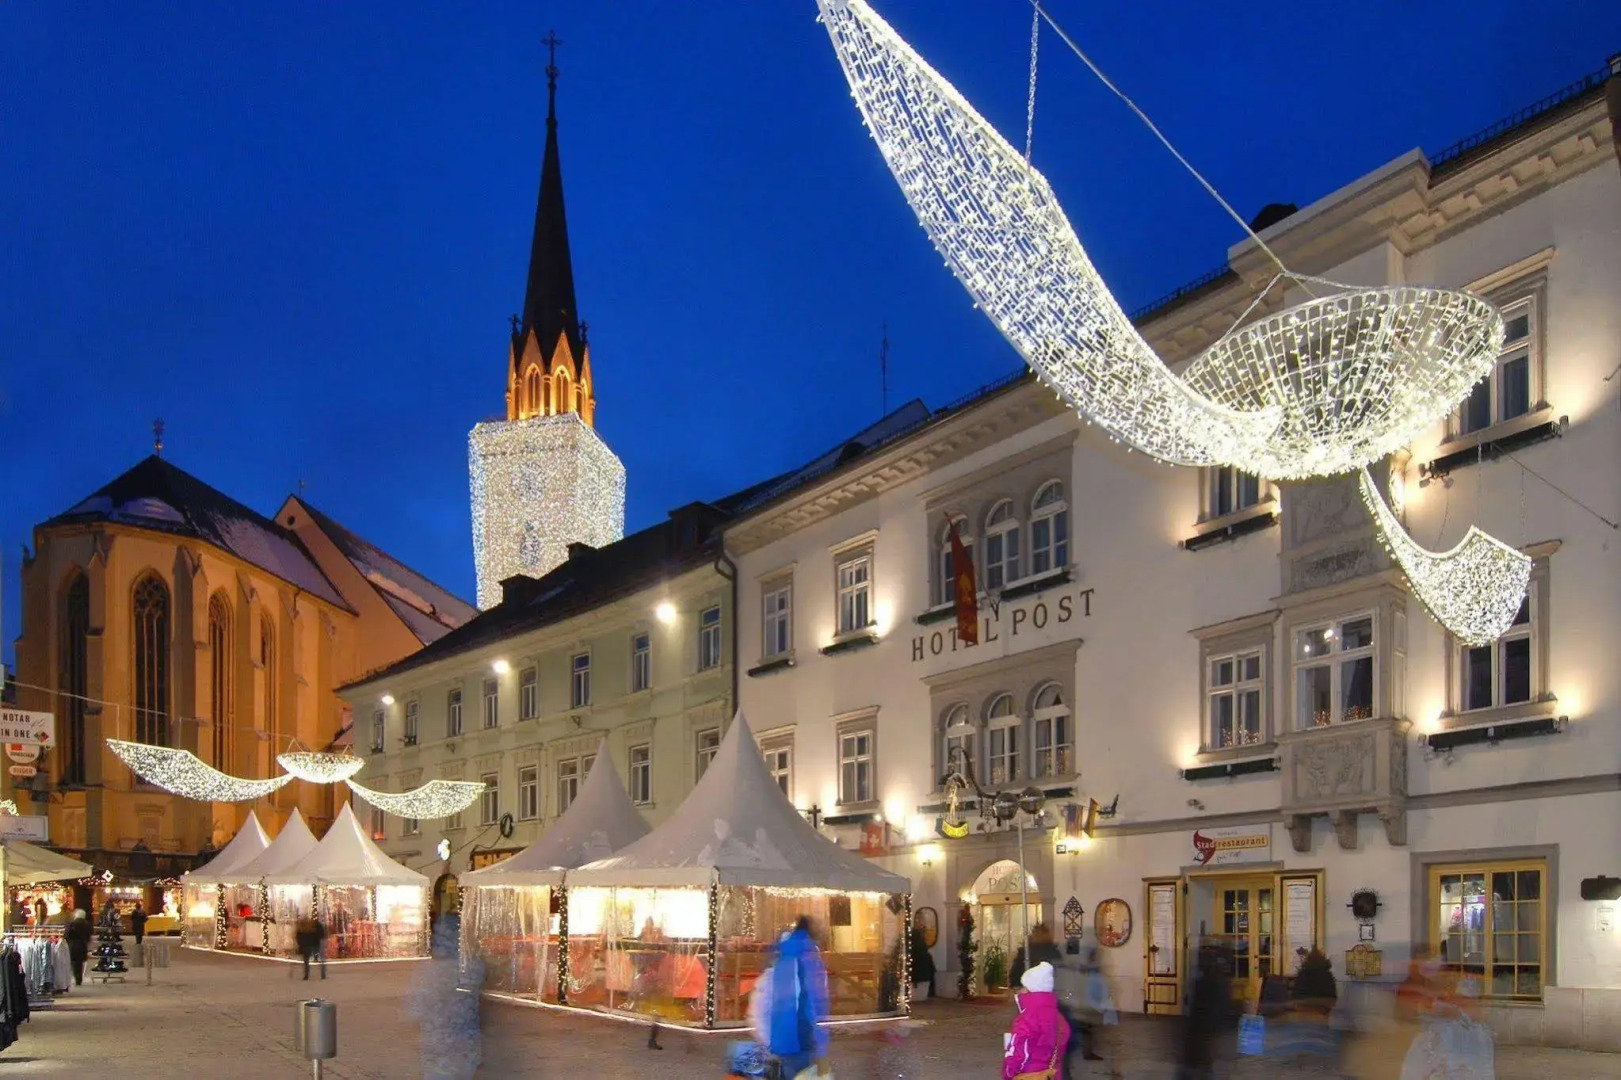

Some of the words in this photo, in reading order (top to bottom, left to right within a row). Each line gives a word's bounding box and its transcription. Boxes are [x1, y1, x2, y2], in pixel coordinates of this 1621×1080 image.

[1011, 588, 1095, 636] POST
[2, 712, 31, 723] NOTAR
[0, 728, 10, 737] IN
[13, 729, 31, 739] ONE
